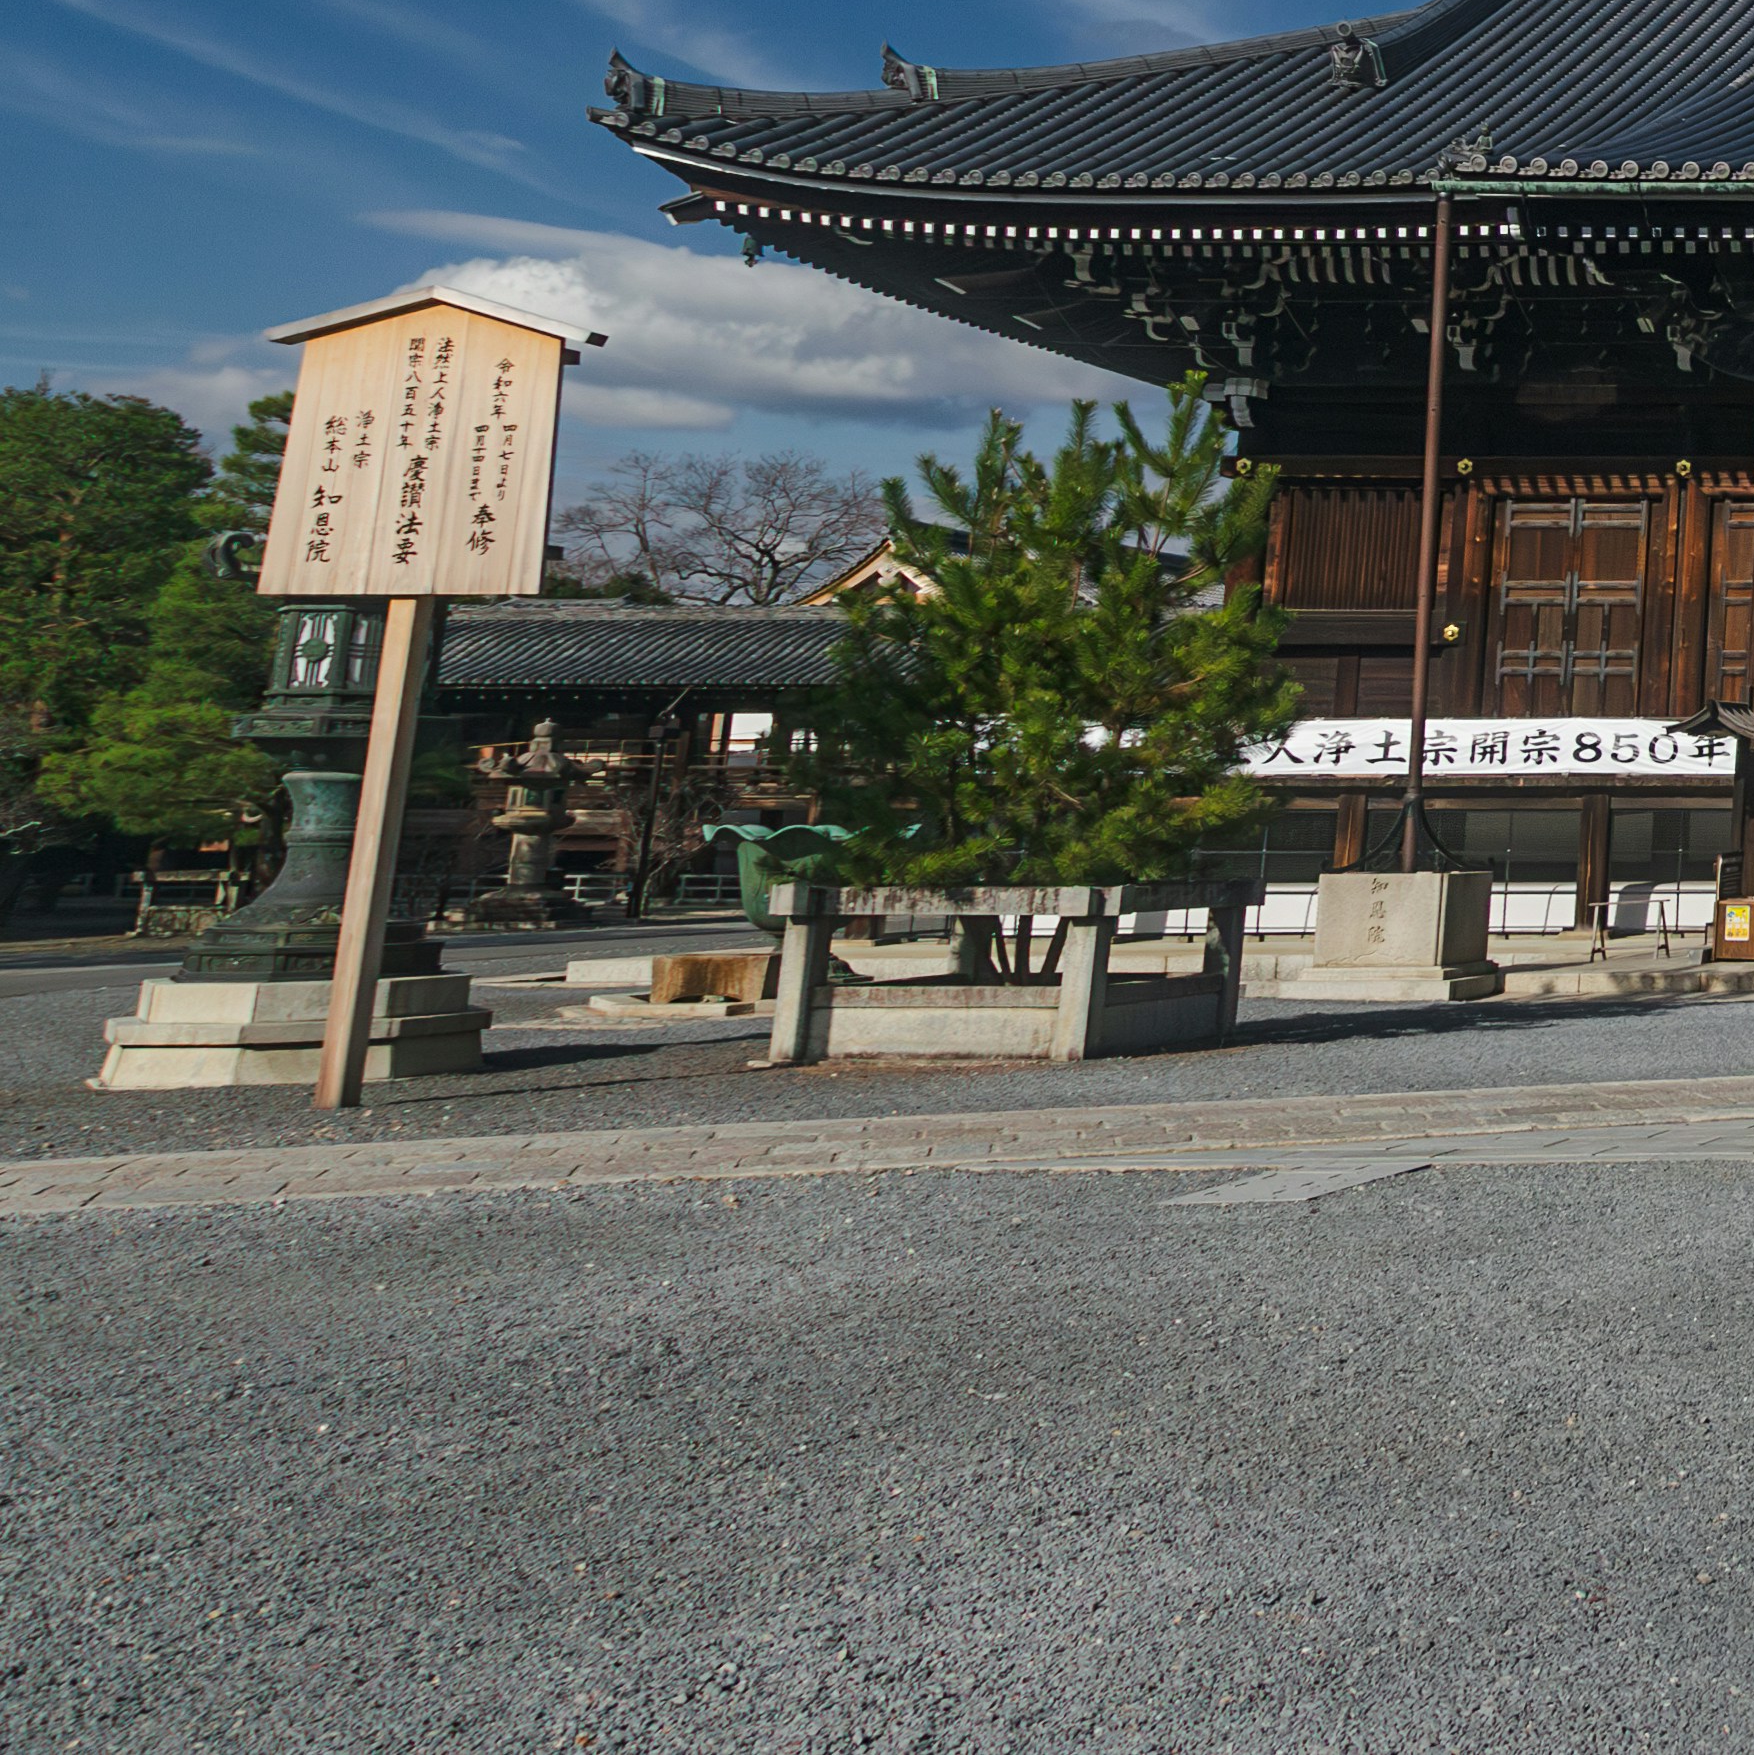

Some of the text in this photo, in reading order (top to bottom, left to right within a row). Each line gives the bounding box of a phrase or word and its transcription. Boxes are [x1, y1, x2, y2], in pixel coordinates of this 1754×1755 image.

[396, 337, 426, 451] 開宗八百五十年
[425, 337, 455, 451] 法然上人浄土宗
[489, 357, 515, 420] 令和六年
[321, 414, 349, 473] 総本山
[352, 409, 376, 469] 浄土宗
[496, 424, 518, 501] 四月七日より
[305, 484, 344, 563] 知恩院
[465, 503, 496, 556] 奉修
